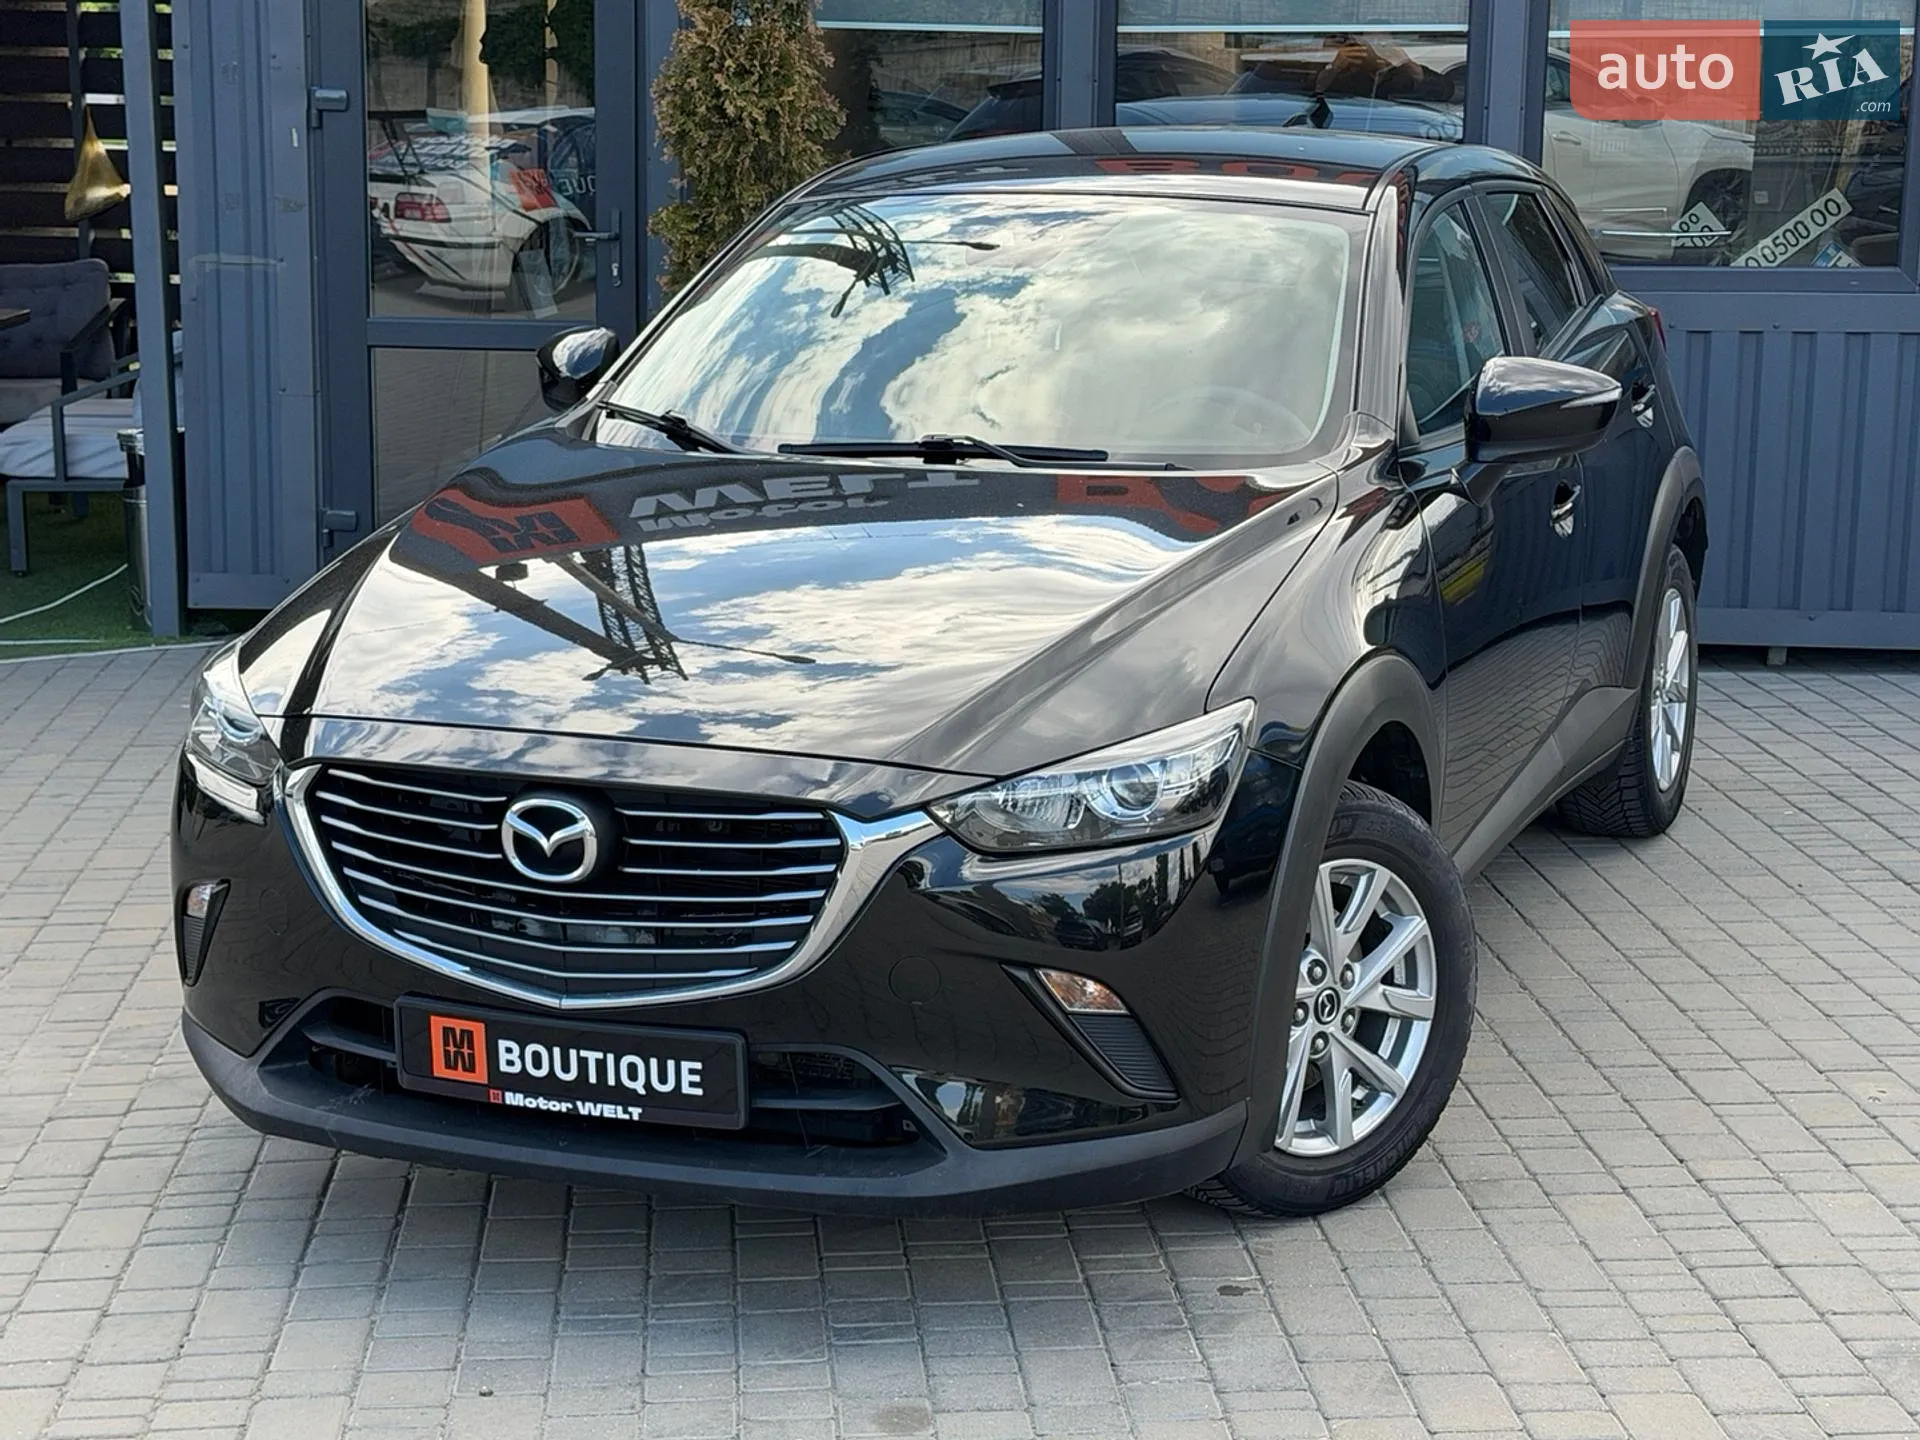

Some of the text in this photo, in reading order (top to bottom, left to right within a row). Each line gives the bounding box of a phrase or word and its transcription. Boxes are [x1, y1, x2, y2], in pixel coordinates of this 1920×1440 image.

[497, 1038, 703, 1096] BOUTIQUE
[504, 1091, 573, 1113] Motor
[576, 1100, 643, 1121] WELT
